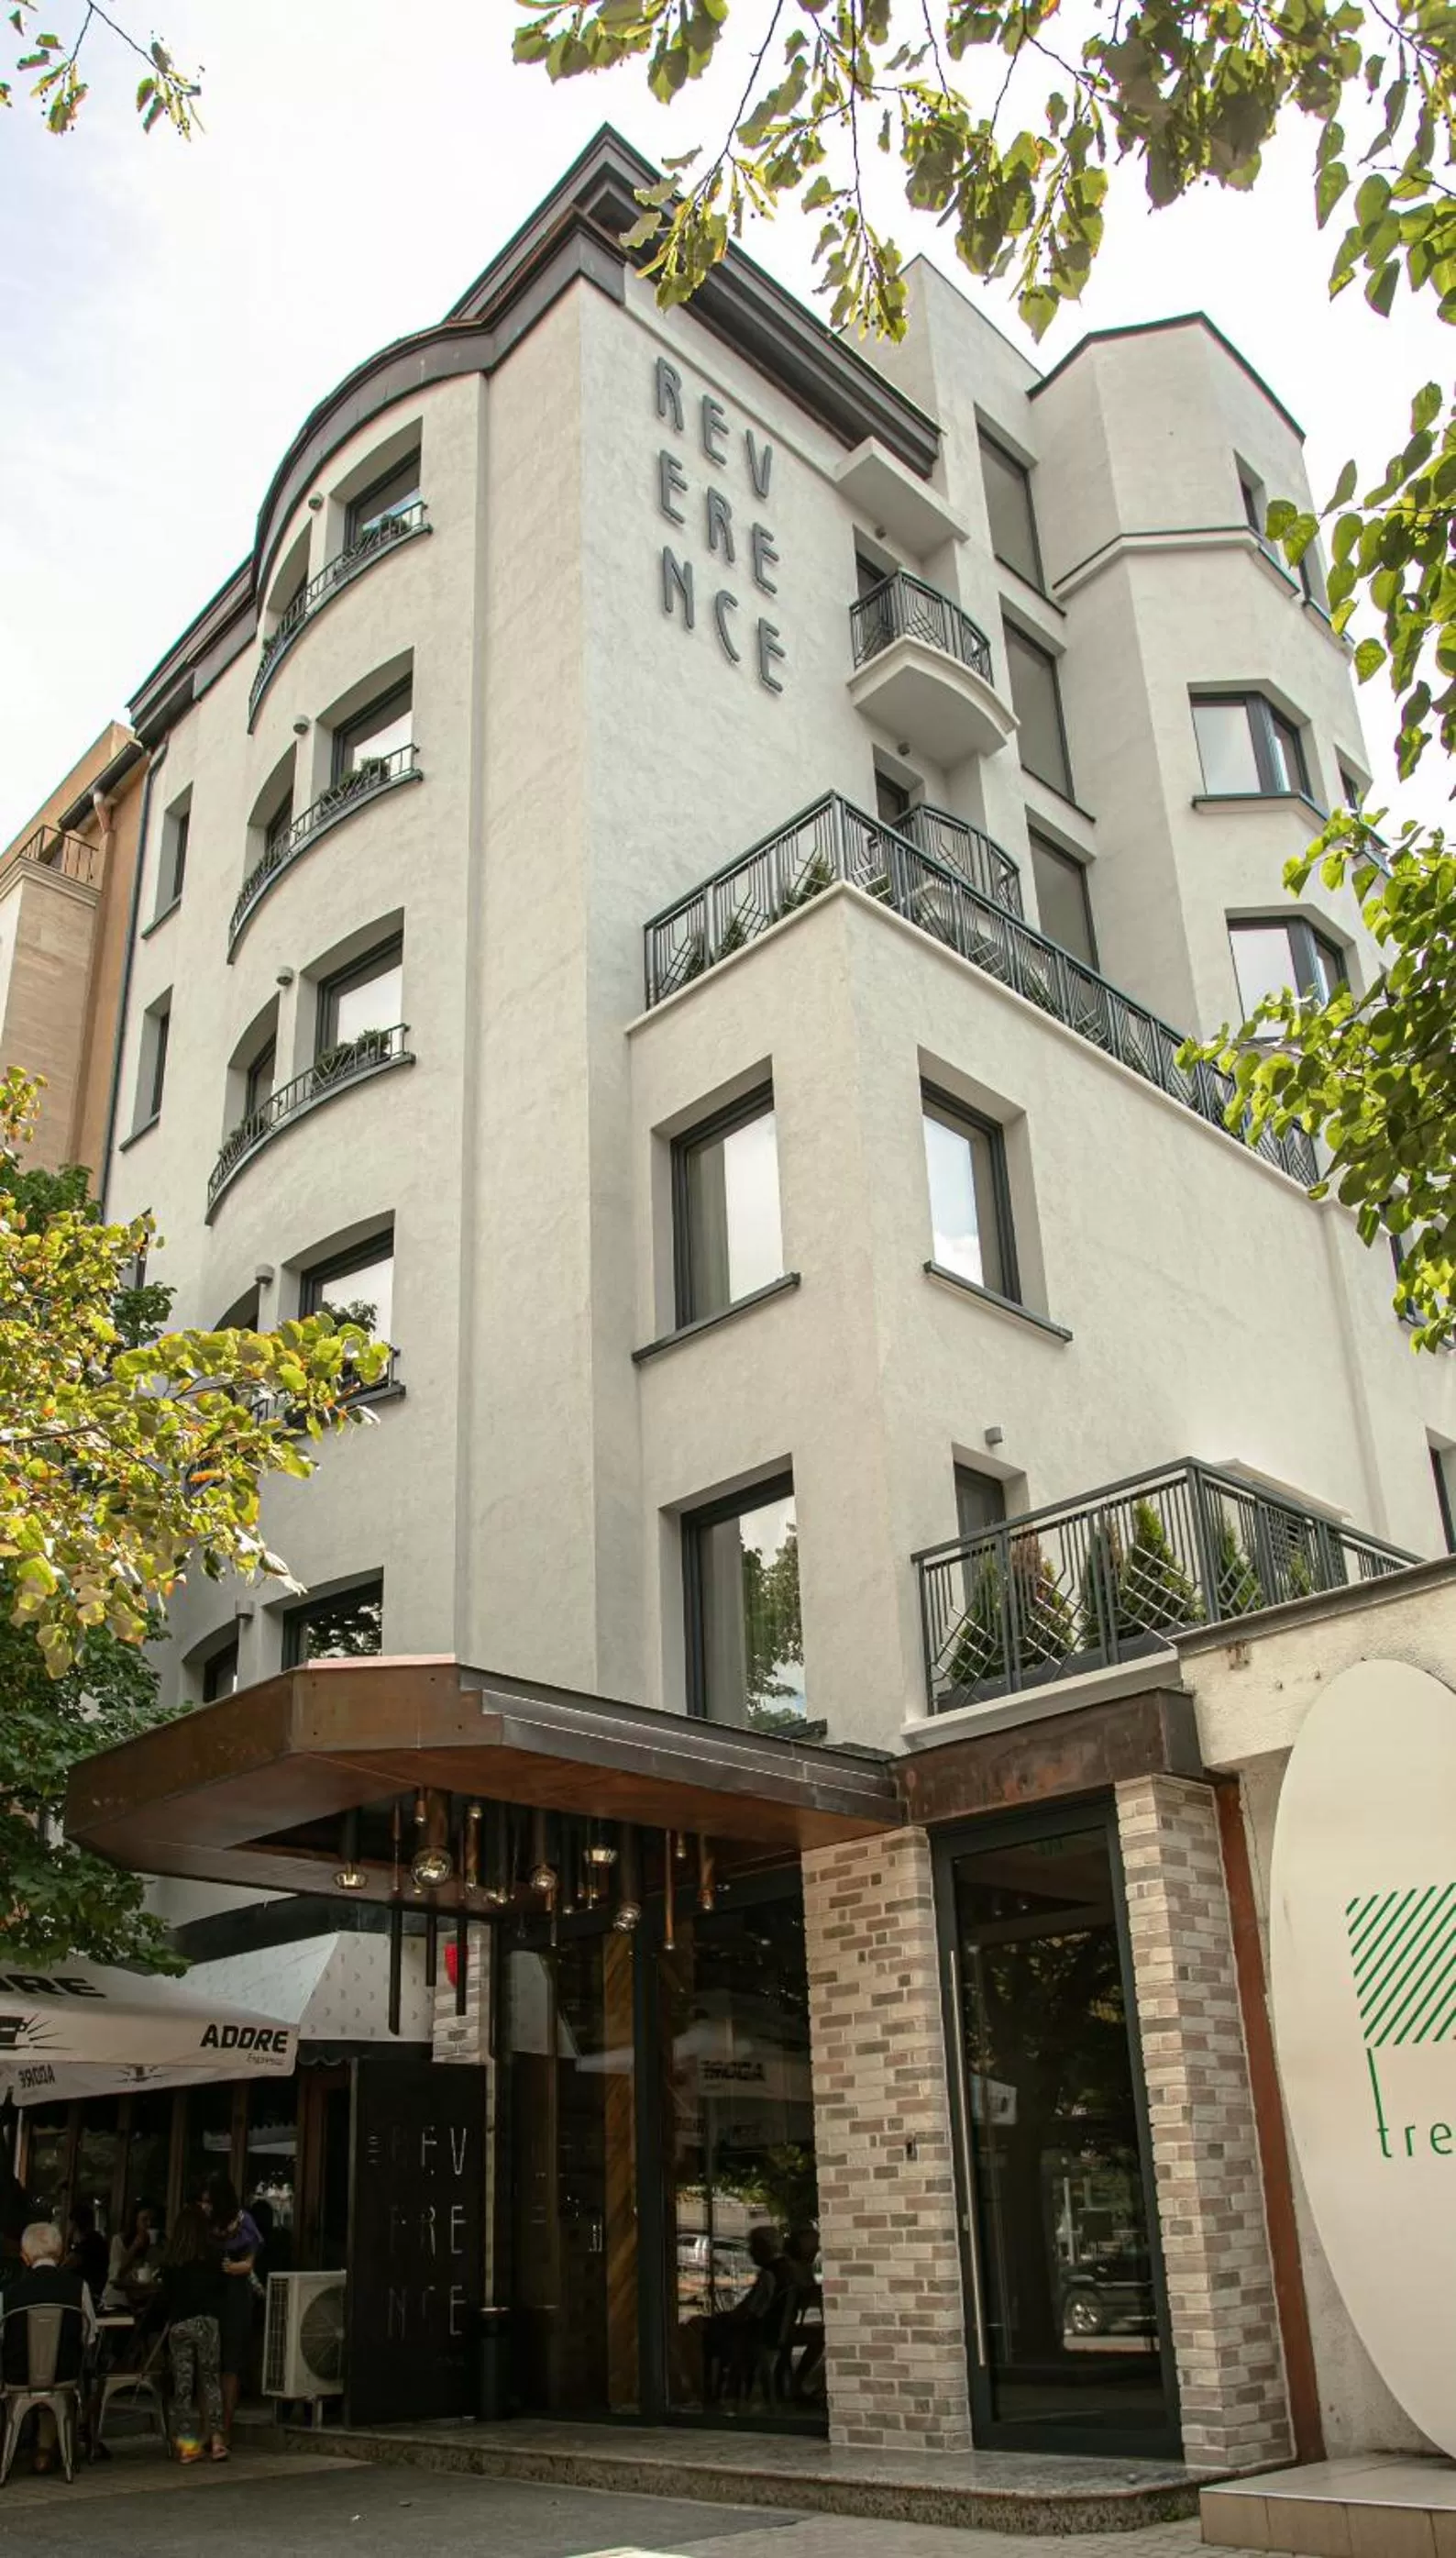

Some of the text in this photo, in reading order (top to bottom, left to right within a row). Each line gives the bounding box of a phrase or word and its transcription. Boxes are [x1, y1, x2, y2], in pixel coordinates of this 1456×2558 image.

[656, 356, 773, 498] REV
[658, 448, 780, 595] ERE
[663, 545, 786, 692] NCE
[200, 2023, 289, 2054] ADORE
